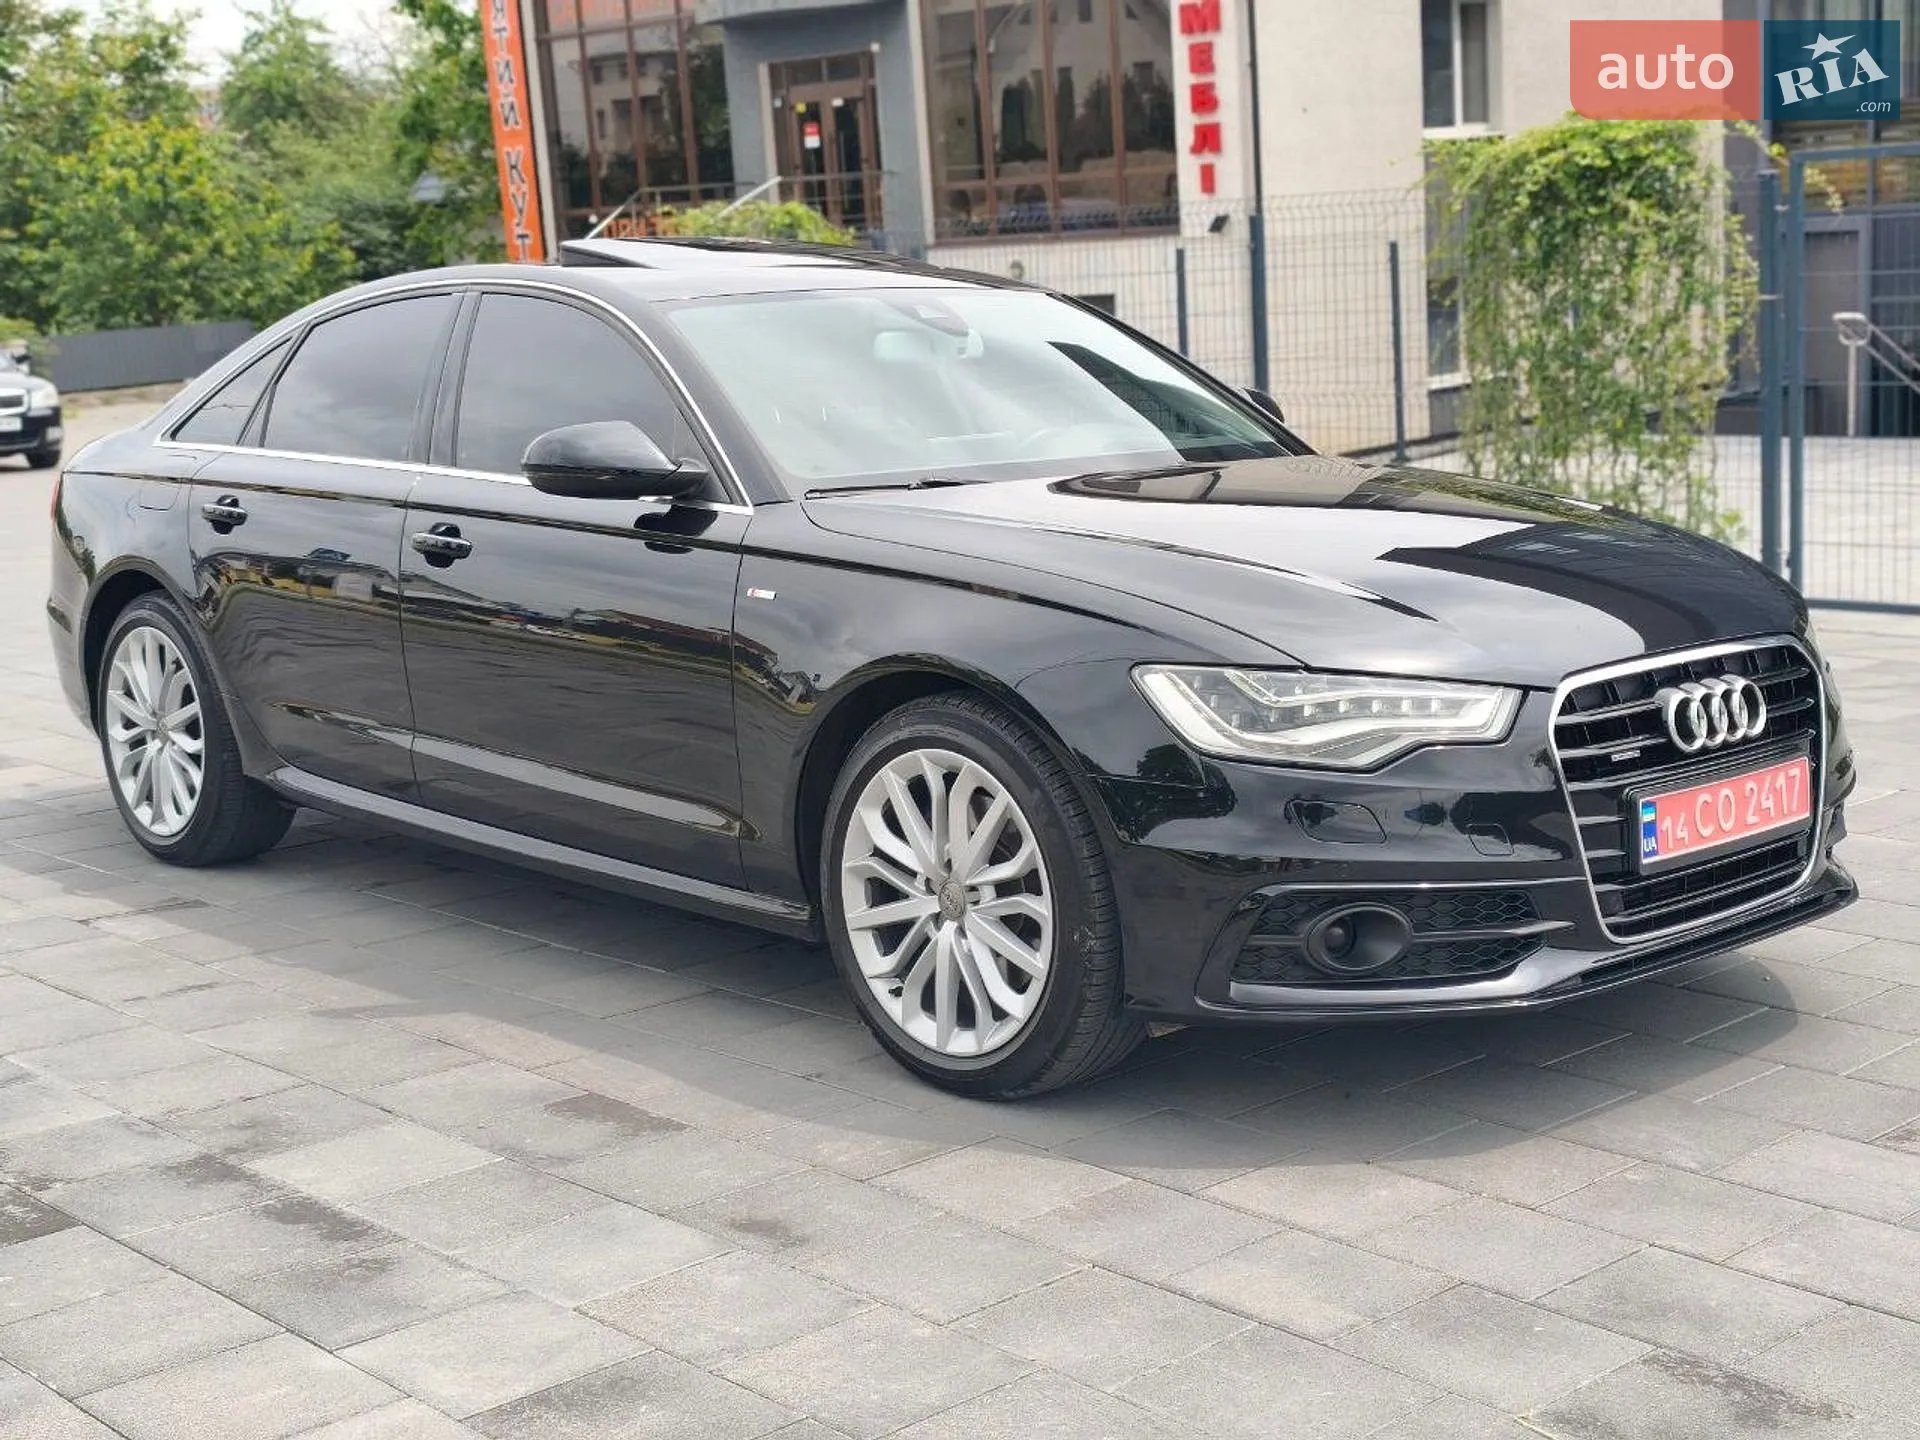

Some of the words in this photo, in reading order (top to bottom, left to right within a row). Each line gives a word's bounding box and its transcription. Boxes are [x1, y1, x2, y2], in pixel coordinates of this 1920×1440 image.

[1178, 0, 1222, 195] МЕБЛІ
[504, 149, 532, 265] КУТ
[1643, 838, 1657, 852] UA
[1661, 811, 1689, 849] 14
[1694, 787, 1736, 838] CO
[1743, 767, 1801, 826] 2417
